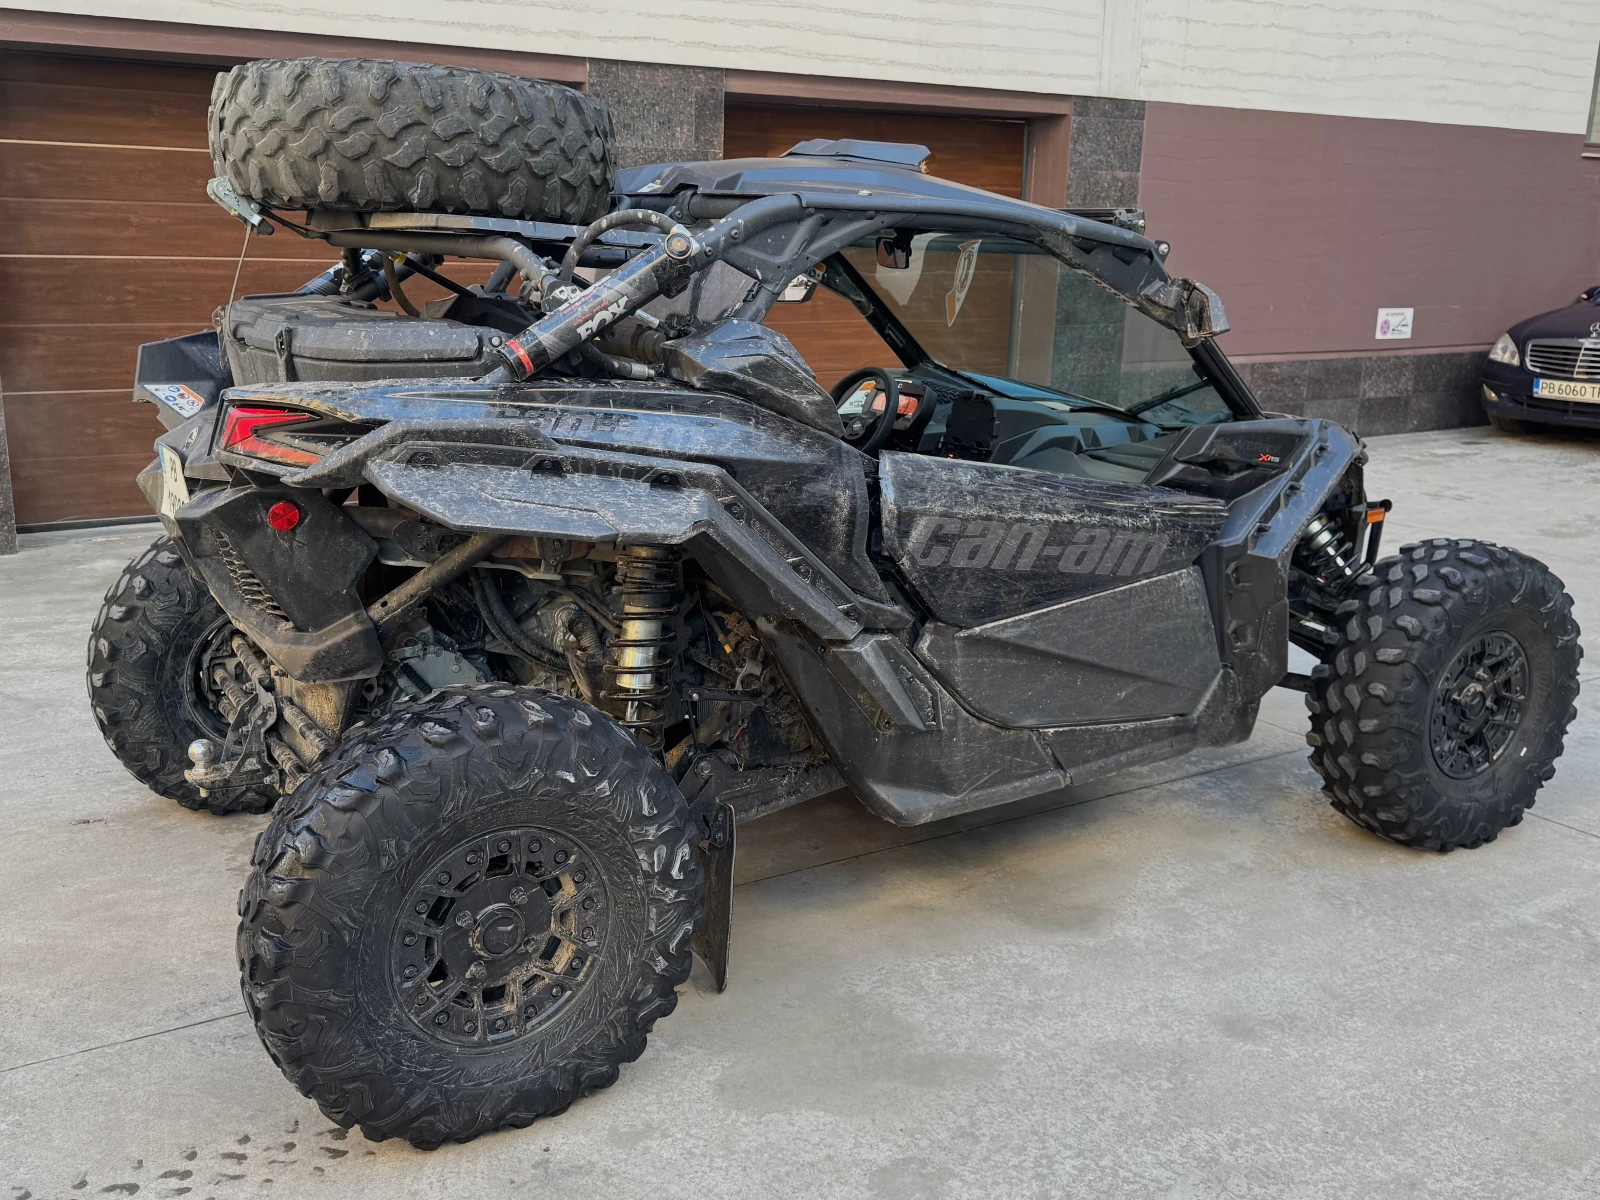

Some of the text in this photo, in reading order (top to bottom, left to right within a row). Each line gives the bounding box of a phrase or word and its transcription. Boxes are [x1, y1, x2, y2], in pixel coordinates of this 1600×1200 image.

[576, 295, 630, 341] FOX
[1541, 382, 1555, 394] PB
[1557, 383, 1587, 397] 6060
[910, 516, 1169, 577] can-am
